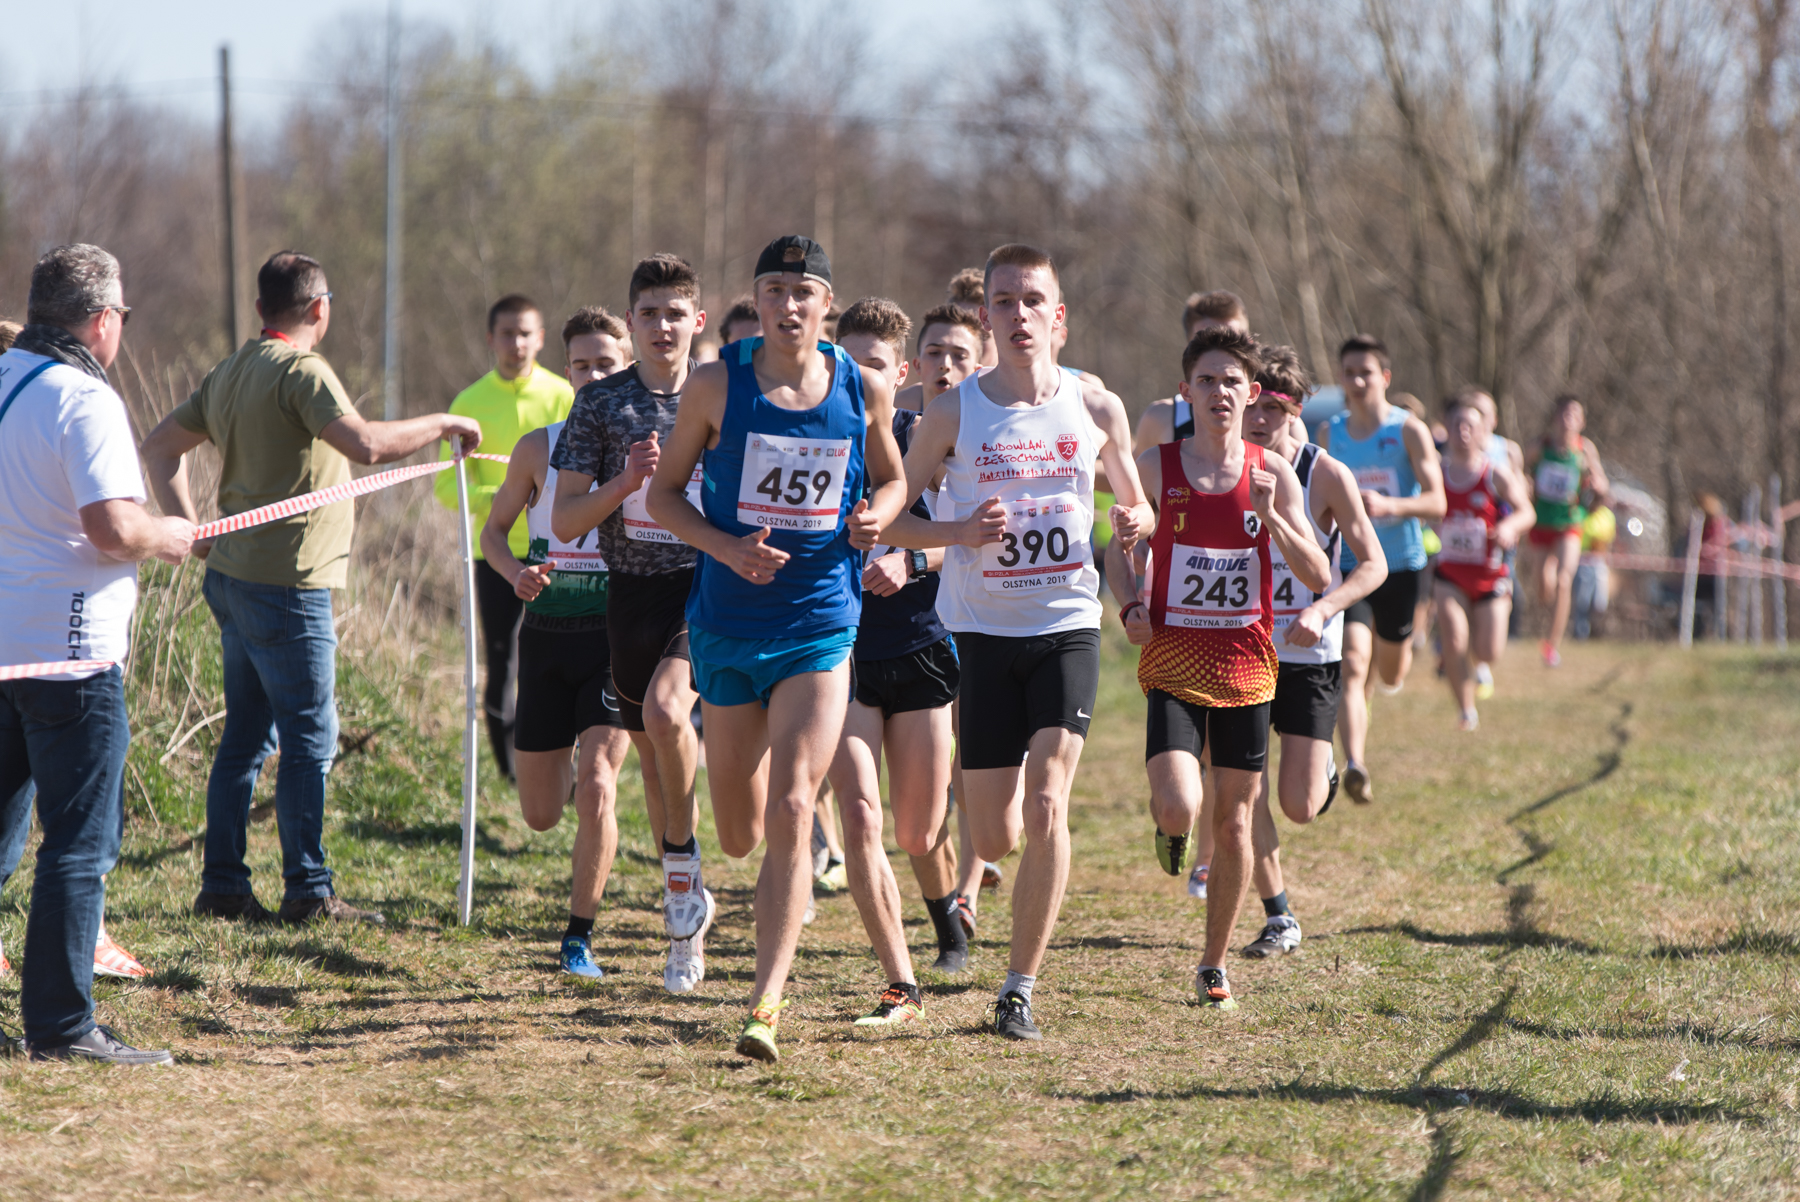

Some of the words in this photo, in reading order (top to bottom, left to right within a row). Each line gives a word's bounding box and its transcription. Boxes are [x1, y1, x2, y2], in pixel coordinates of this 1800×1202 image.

[834, 448, 846, 457] LUG
[756, 467, 831, 506] 459
[1063, 503, 1075, 513] LUG
[757, 515, 798, 528] OLSZYNA
[803, 519, 822, 528] 2019
[1173, 512, 1187, 532] J
[636, 530, 673, 541] OLSZYNA
[997, 526, 1069, 567] 390
[564, 561, 600, 570] OLSZYNA
[1002, 578, 1042, 589] OLSZYNA
[1046, 574, 1067, 585] 2019
[1181, 574, 1249, 608] 243
[1273, 577, 1295, 606] 4
[537, 614, 576, 630] NIKE
[580, 615, 607, 629] PR
[1183, 618, 1220, 627] OLSZYNA
[1224, 619, 1243, 627] 2019
